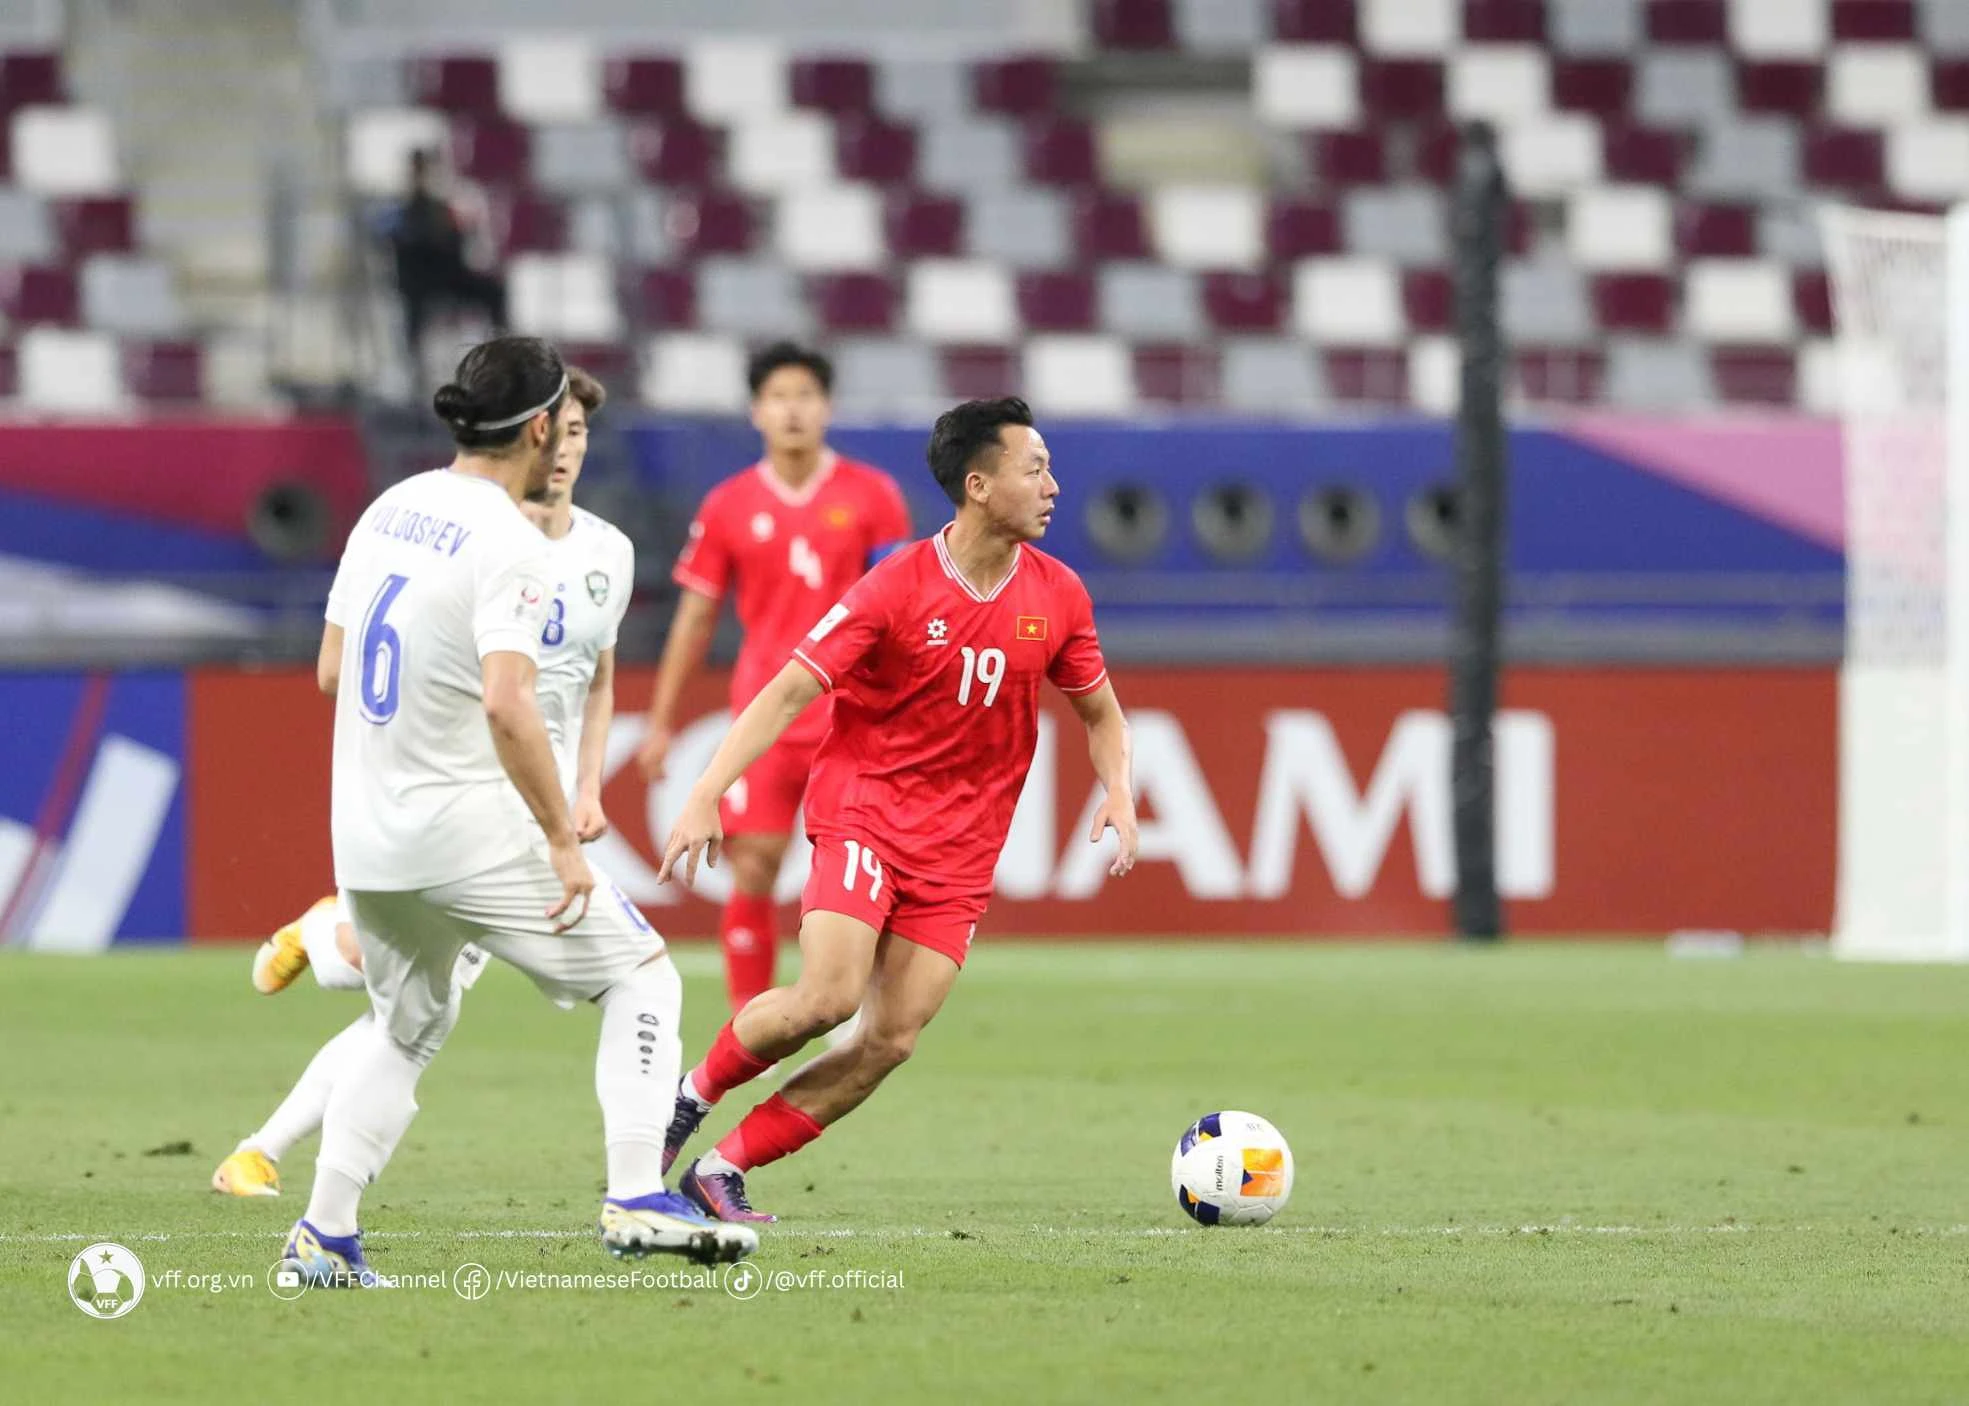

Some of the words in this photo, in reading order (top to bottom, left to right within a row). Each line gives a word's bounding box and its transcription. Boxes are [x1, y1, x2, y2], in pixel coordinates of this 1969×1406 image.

[789, 535, 823, 590] 4
[359, 573, 410, 726] 6
[957, 646, 1007, 708] 19
[842, 840, 884, 902] 19
